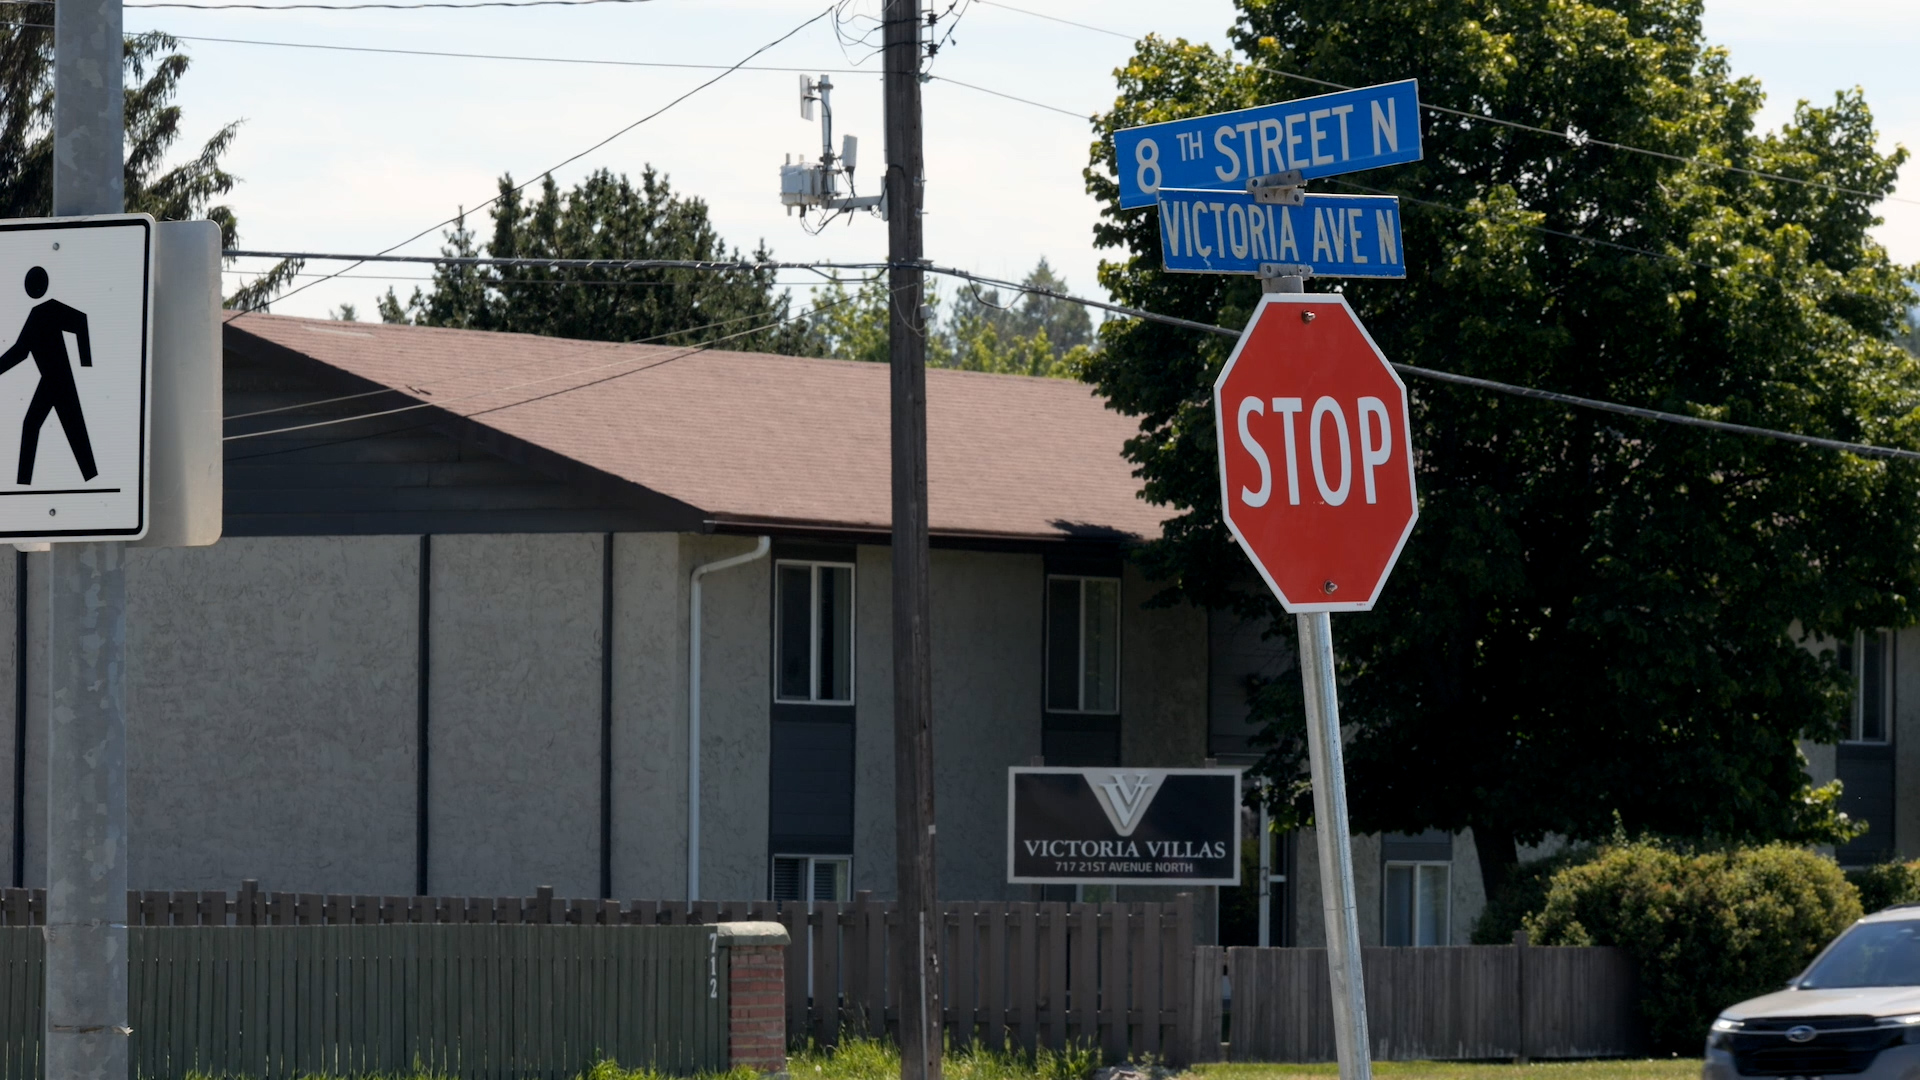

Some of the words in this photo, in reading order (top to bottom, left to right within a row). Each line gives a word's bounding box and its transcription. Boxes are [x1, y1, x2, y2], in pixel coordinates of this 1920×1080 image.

[1135, 138, 1162, 194] 8
[1176, 130, 1204, 162] TH
[1213, 103, 1354, 182] STREET
[1370, 97, 1399, 156] N
[1160, 200, 1300, 262] VICTORIA
[1312, 206, 1368, 264] AVE
[1375, 208, 1398, 265] N
[1237, 395, 1392, 508] STOP
[1024, 839, 1140, 858] VICTORIA
[1145, 840, 1226, 859] VILLAS
[1055, 861, 1076, 873] 717
[1078, 861, 1107, 873] 21ST
[1109, 861, 1153, 873] AVENUE
[1155, 862, 1193, 873] NORTH
[709, 932, 718, 999] 712
